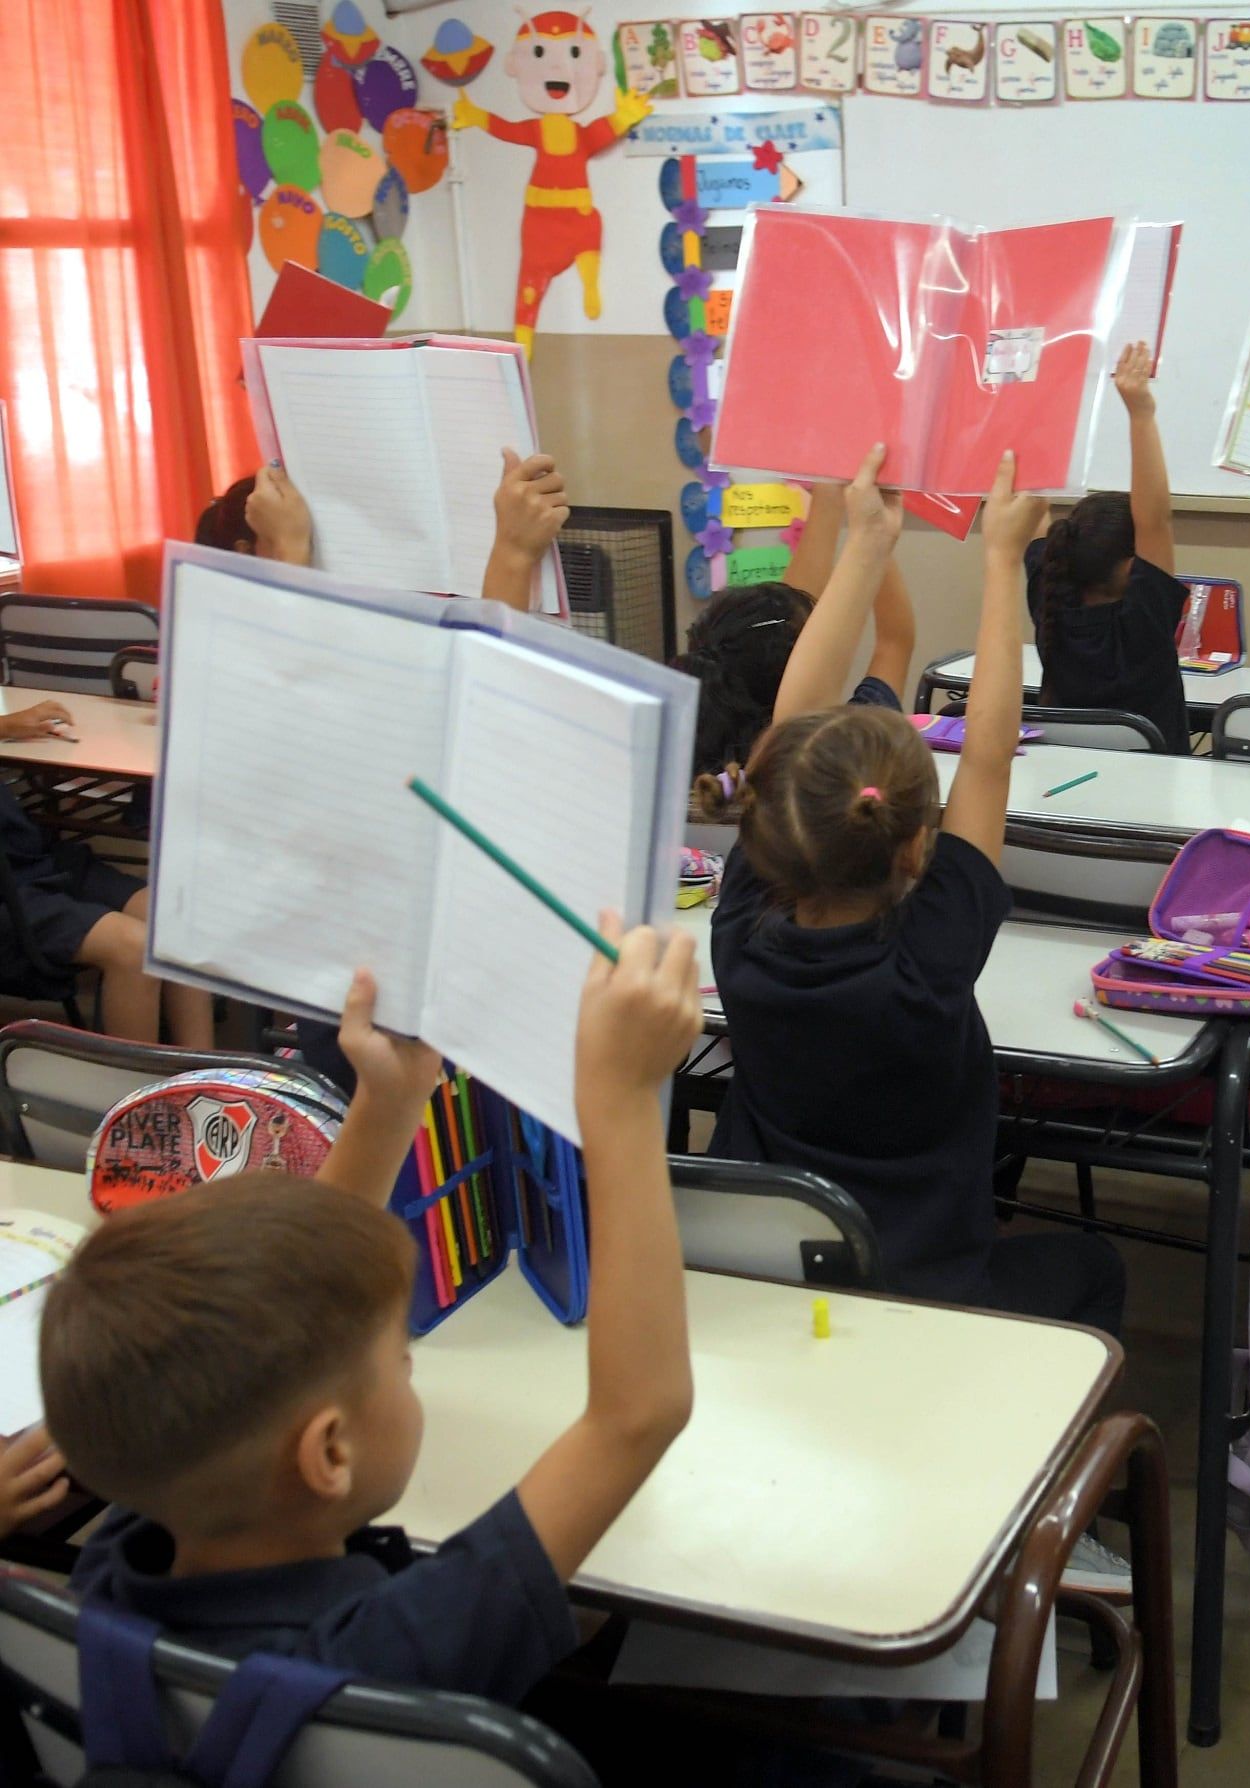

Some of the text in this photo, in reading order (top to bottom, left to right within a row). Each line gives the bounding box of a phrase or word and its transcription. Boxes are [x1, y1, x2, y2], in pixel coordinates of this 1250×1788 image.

[626, 28, 640, 44] A
[743, 26, 757, 44] C
[805, 18, 819, 37] D
[872, 25, 886, 44] E
[935, 26, 949, 44] F
[1141, 27, 1149, 46] I
[684, 32, 697, 51] B
[1001, 38, 1016, 57] G
[1067, 29, 1083, 48] H
[1212, 32, 1225, 52] J
[724, 126, 746, 142] DE
[755, 121, 807, 141] CLASE
[111, 1128, 181, 1155] PLATE
